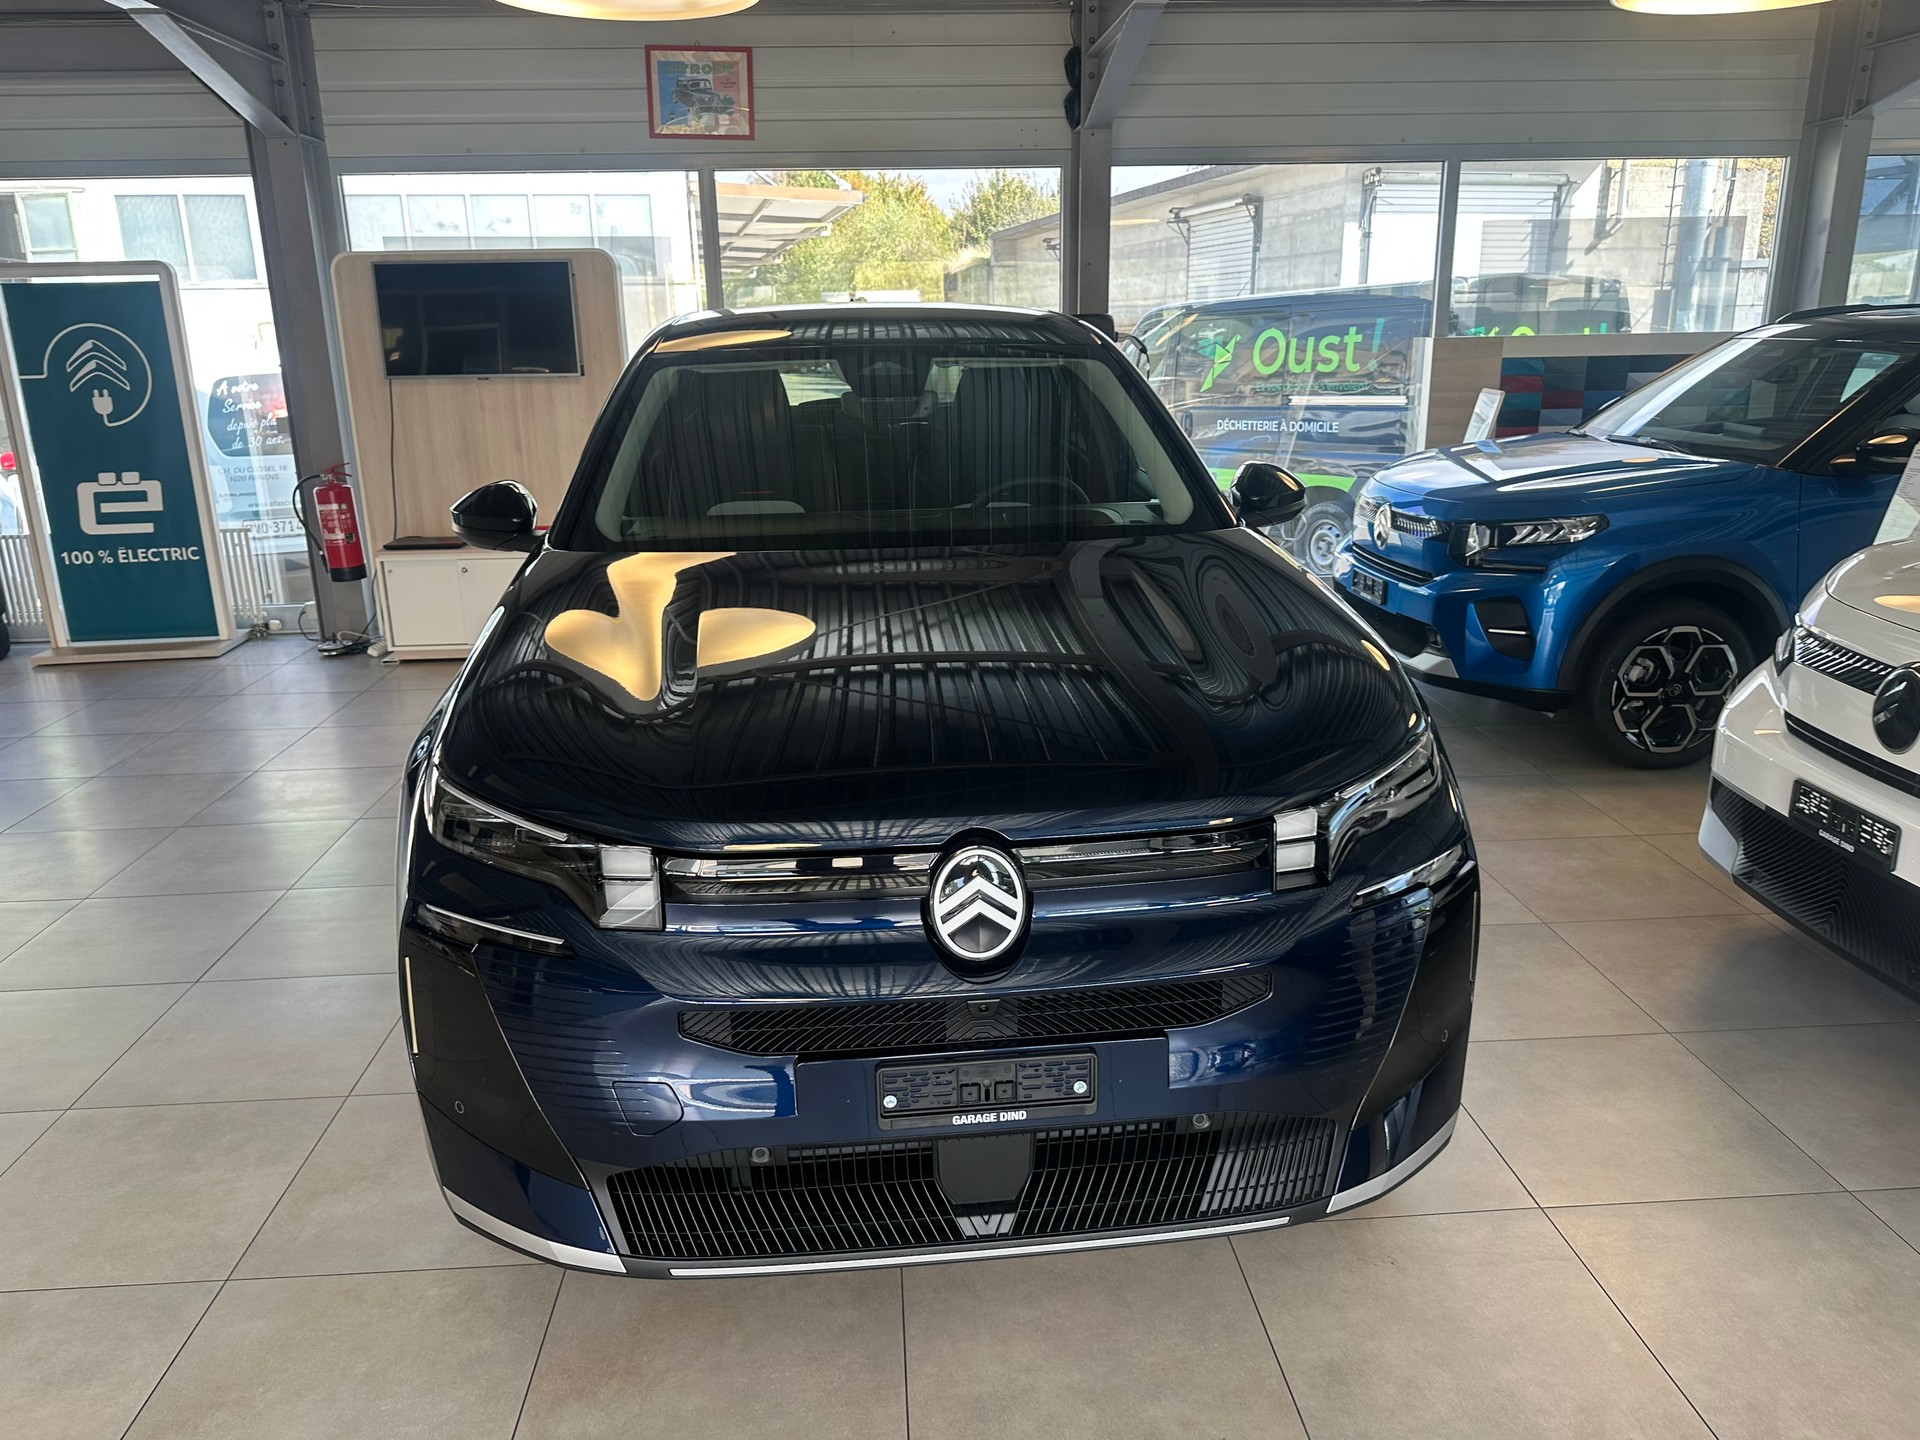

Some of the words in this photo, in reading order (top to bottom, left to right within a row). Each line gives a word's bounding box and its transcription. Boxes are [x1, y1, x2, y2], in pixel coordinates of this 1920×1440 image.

[1216, 418, 1279, 431] DÉCHETTERIE
[1280, 419, 1288, 432] À
[1289, 421, 1340, 433] DOMICILE
[246, 465, 276, 473] COSEL
[60, 550, 94, 565] 100
[97, 550, 114, 564] %
[952, 1112, 998, 1125] GARAGE
[999, 1110, 1027, 1122] DIND
